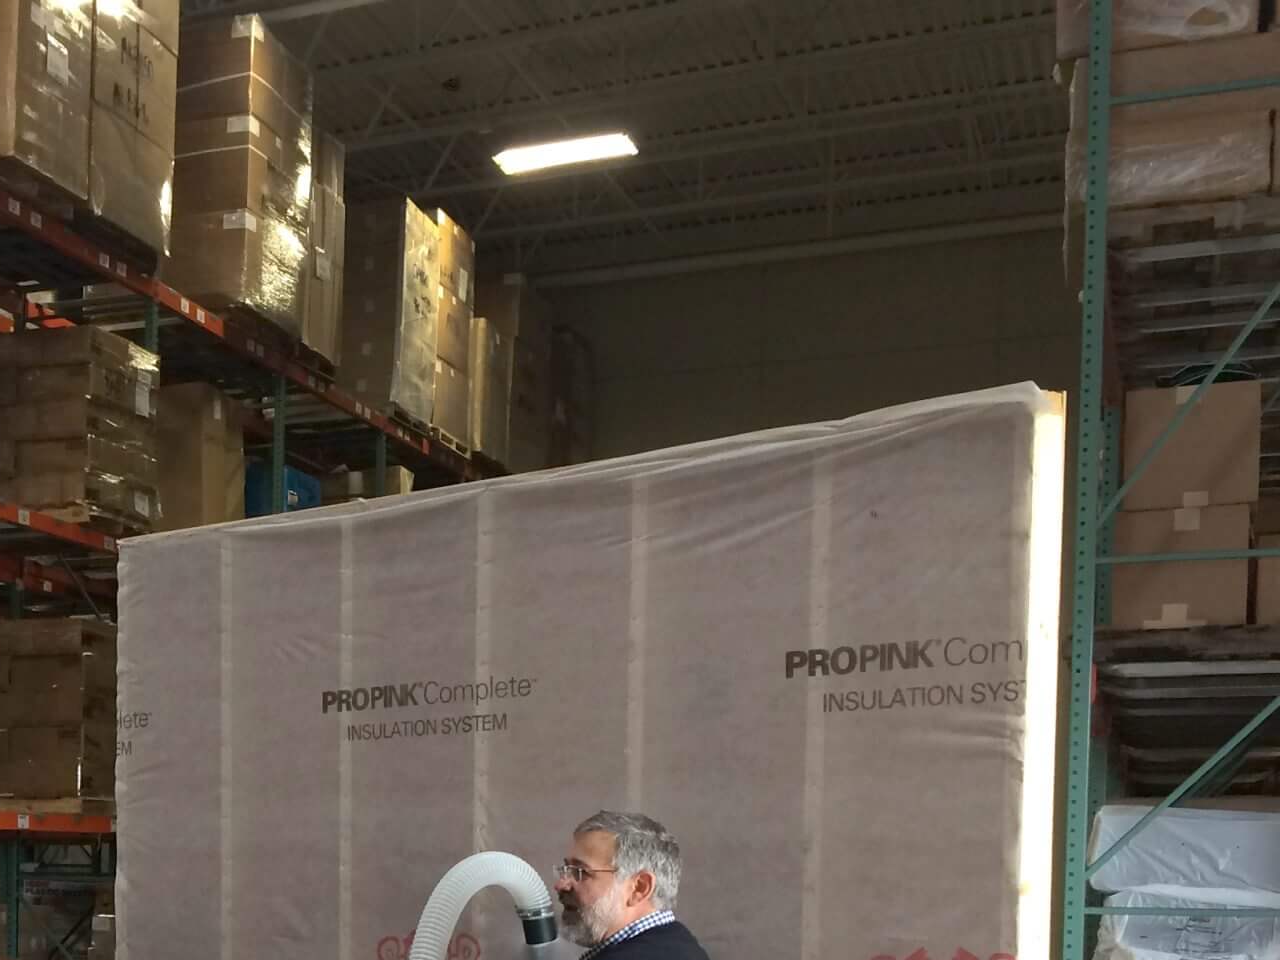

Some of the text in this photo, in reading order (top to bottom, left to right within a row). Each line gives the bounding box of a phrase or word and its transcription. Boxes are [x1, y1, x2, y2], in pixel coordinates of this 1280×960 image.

[823, 684, 964, 712] INSULATION
[347, 713, 508, 741] INSULATION SYSTEM
